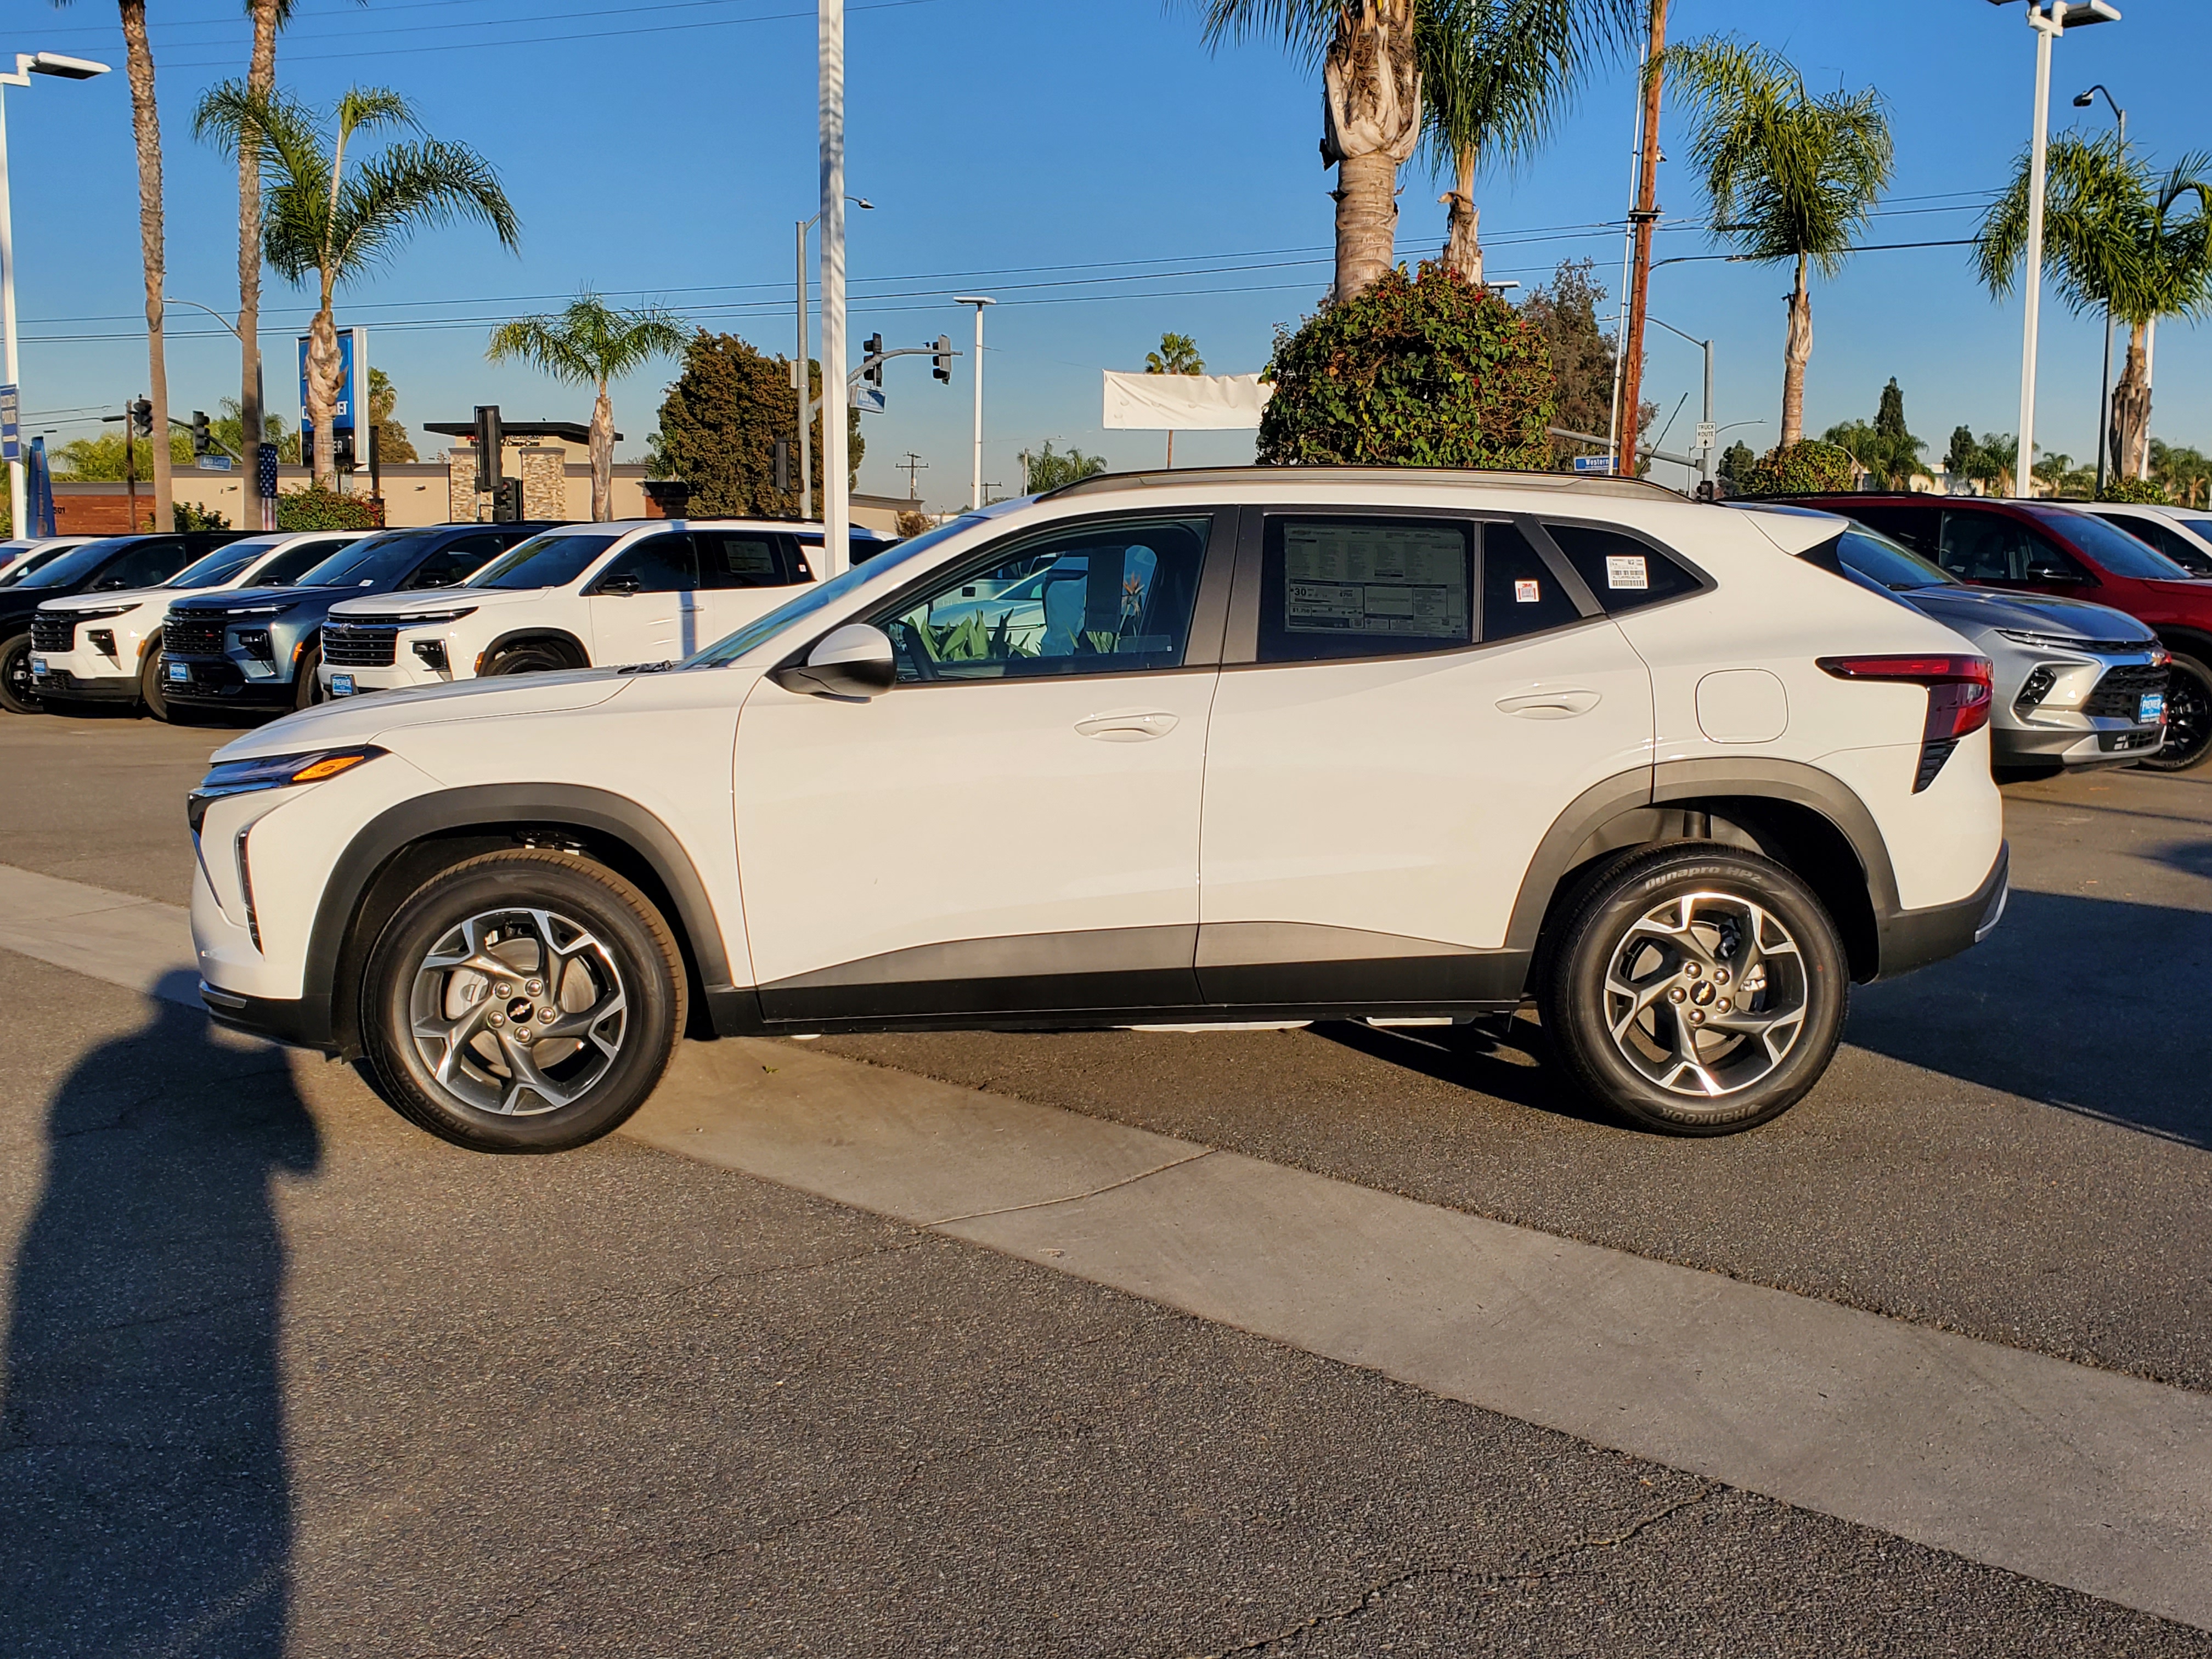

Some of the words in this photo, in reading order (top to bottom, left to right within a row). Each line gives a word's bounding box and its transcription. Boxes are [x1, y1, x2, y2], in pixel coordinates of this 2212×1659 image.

[1295, 588, 1307, 596] 30
[1645, 866, 1720, 890] Dynapro
[1725, 866, 1763, 883] HP2
